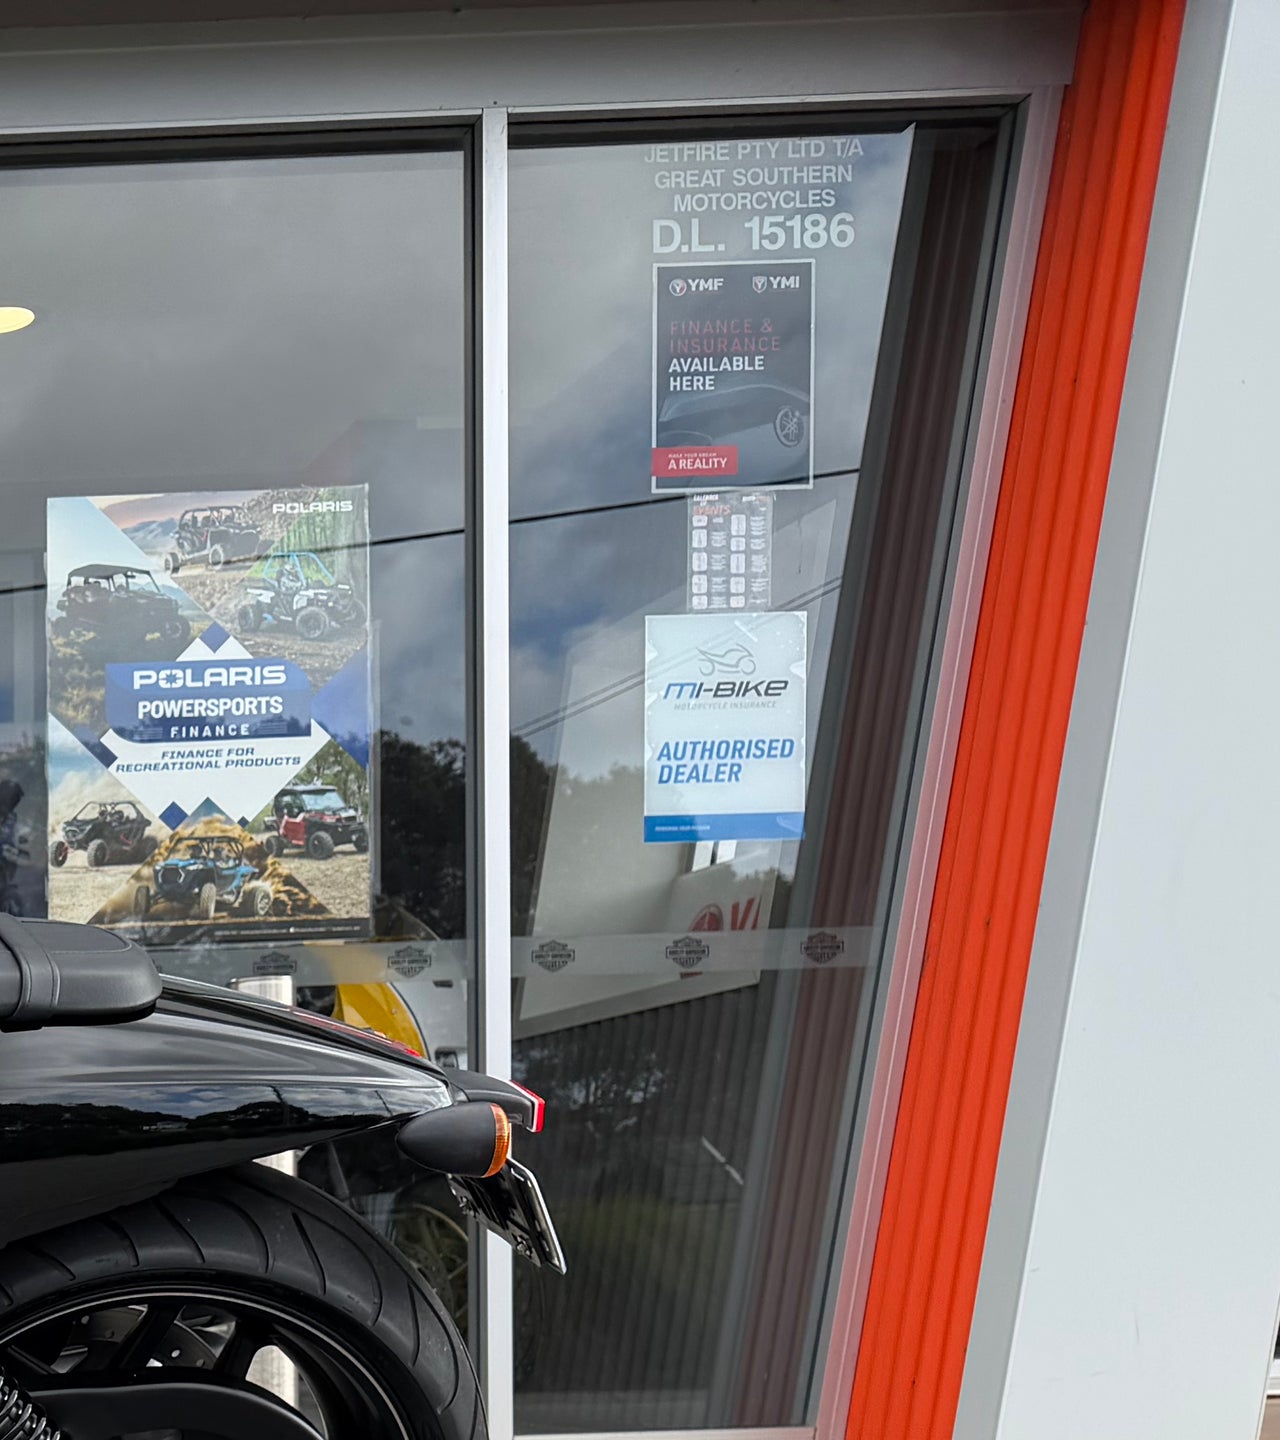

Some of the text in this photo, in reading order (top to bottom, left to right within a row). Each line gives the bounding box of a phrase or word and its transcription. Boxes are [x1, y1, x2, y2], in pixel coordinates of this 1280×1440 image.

[645, 138, 864, 164] JETFIRE PTY LTD T/A
[654, 164, 852, 189] GREAT SOUTHERN
[674, 189, 836, 212] MOTORCYCLES
[652, 212, 855, 253] D.L. 15186
[687, 278, 724, 292] YMF
[769, 276, 800, 290] YMI
[670, 318, 774, 335] FINANCE &
[669, 337, 781, 353] INSURANCE
[668, 355, 765, 373] AVAILABLE
[669, 376, 715, 391] HERE
[668, 457, 727, 470] A REALITY
[272, 500, 353, 514] POLARIS
[133, 664, 287, 690] POLARIS
[137, 696, 283, 720] POWERSPORTS
[170, 724, 250, 738] FINANCE
[161, 746, 255, 760] FINANCE FOR
[657, 738, 795, 762] AUTHORISED
[115, 756, 301, 774] RECREATIONAL PRODUCTS
[657, 763, 743, 785] DEALER
